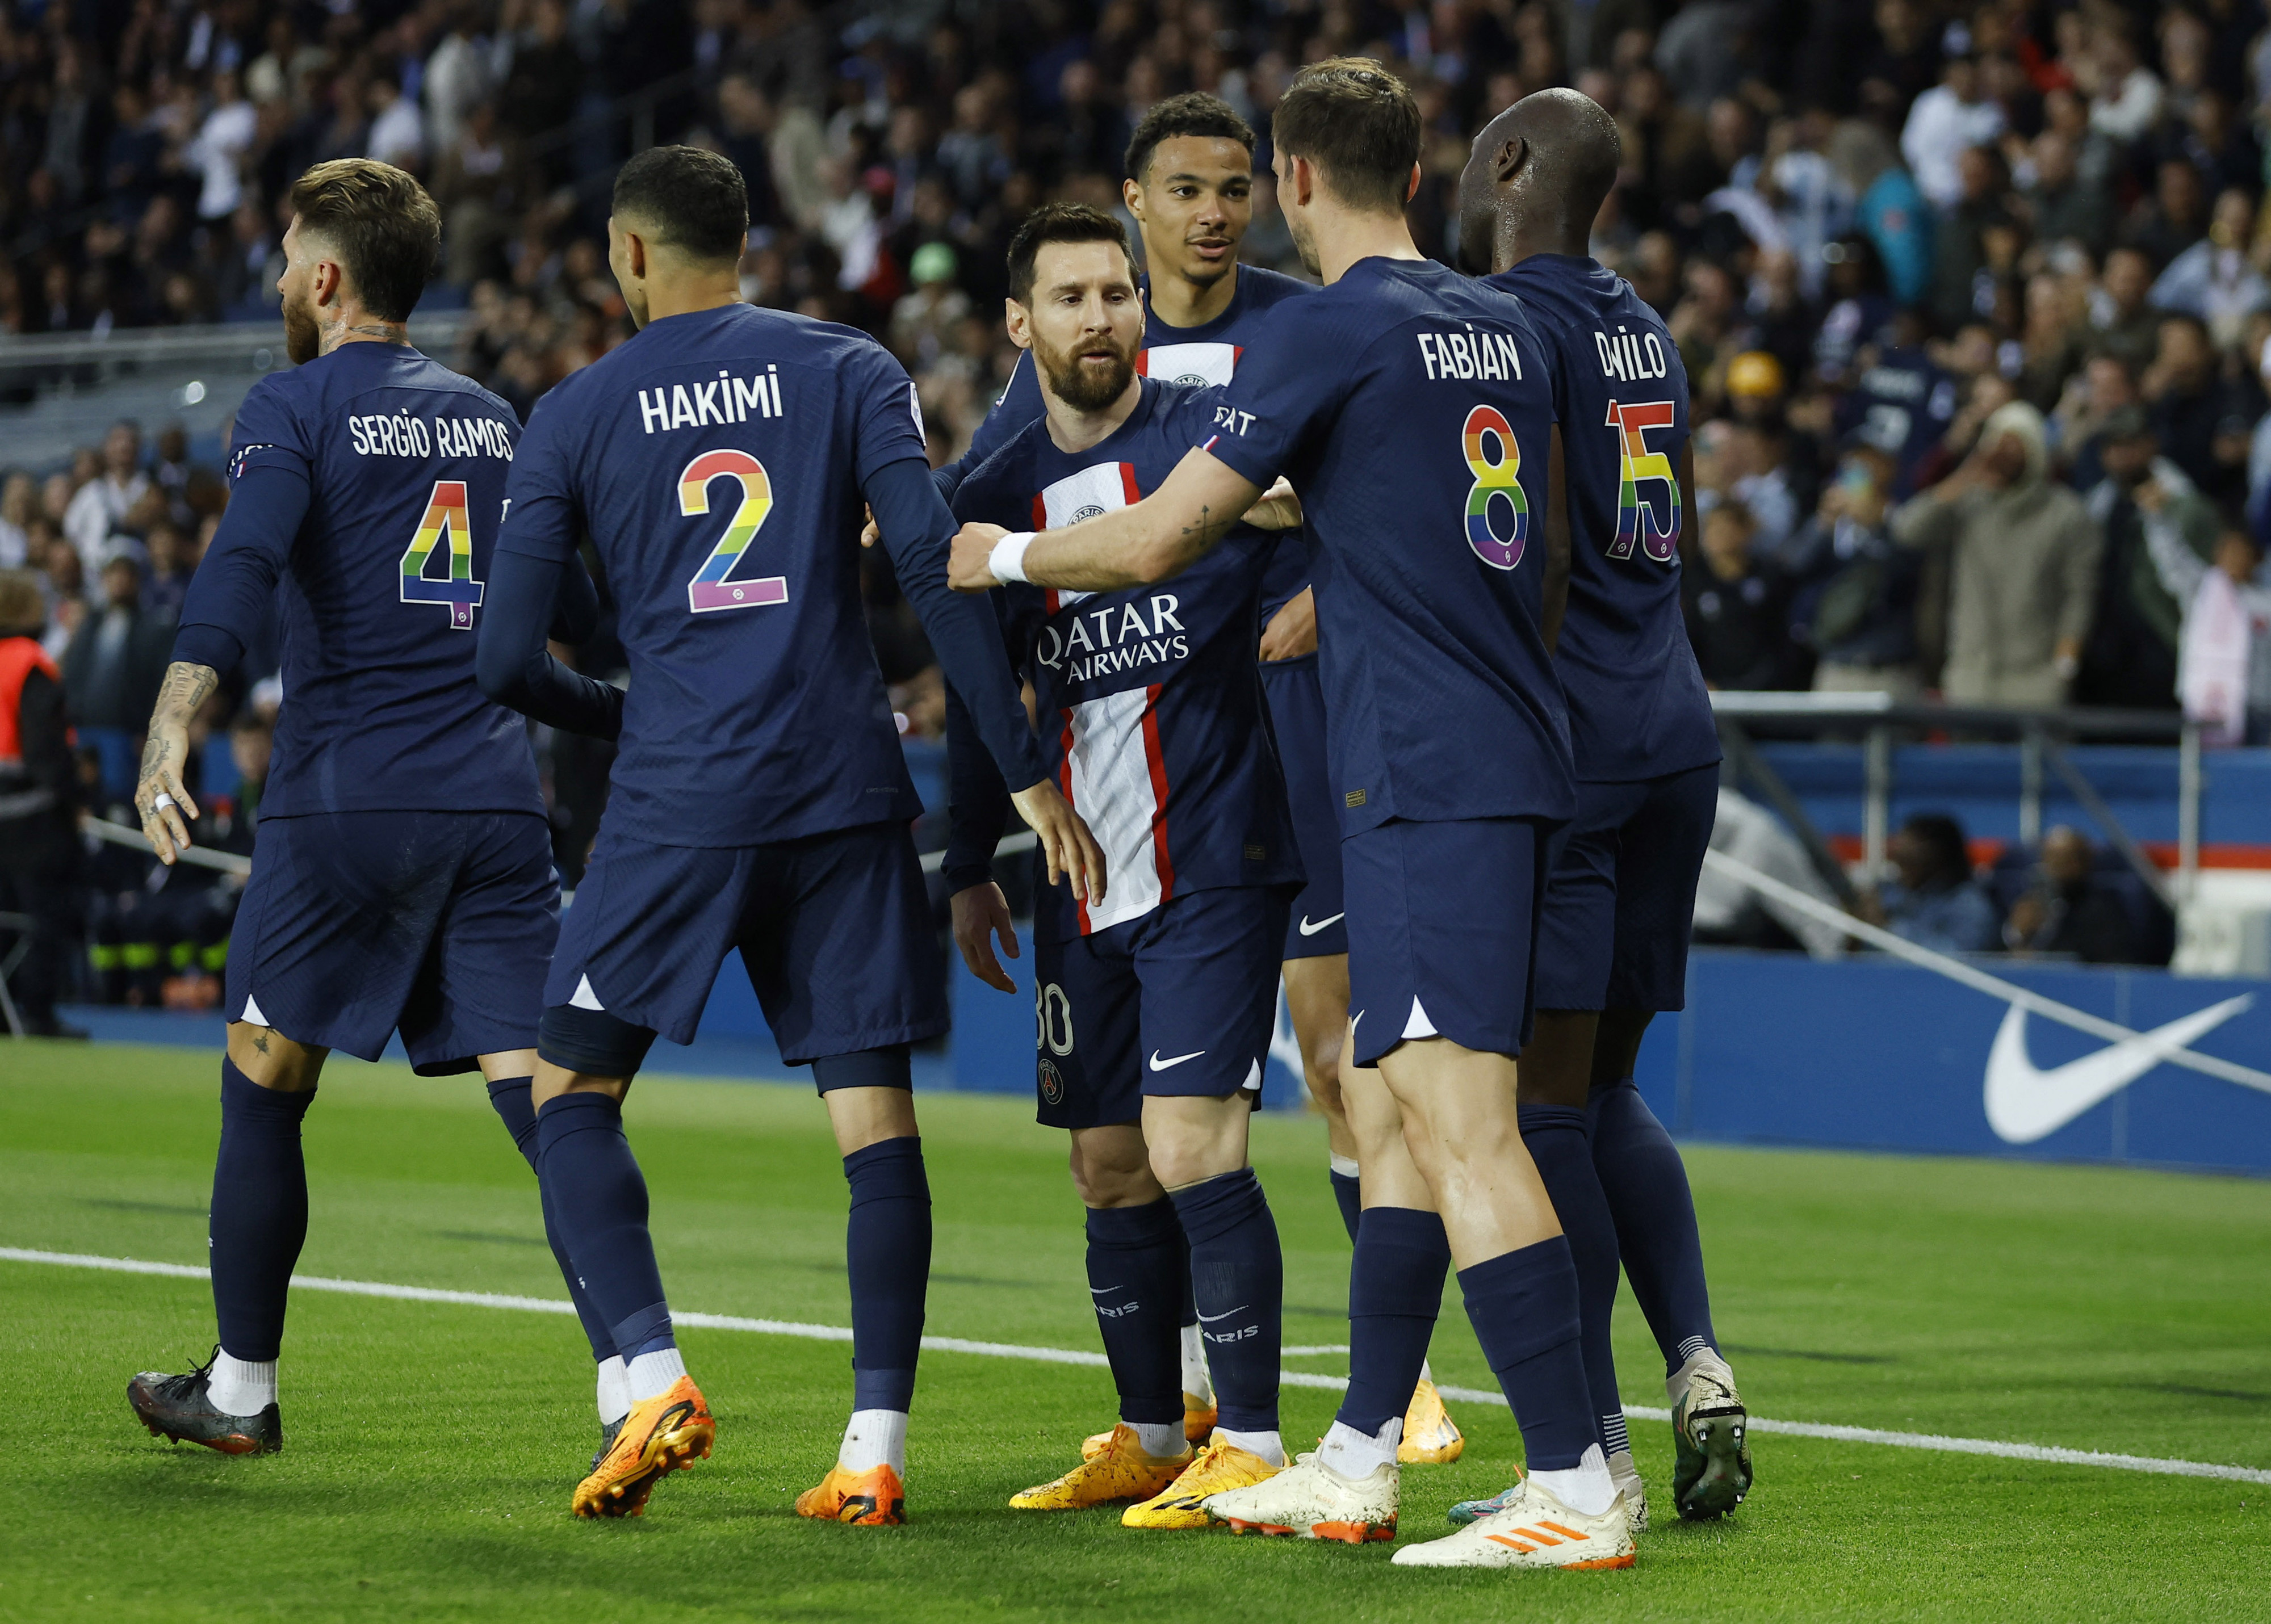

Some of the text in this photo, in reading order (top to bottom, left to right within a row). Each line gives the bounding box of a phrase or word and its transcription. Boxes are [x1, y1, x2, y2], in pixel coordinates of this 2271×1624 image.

[435, 417, 513, 461] RAMOS
[1461, 404, 1528, 570] 8
[1604, 398, 1681, 561] 15
[400, 480, 485, 630] 4
[677, 448, 789, 613] 2
[1037, 594, 1185, 670] QATAR
[1067, 635, 1189, 685] AIRWAYS
[1040, 1061, 1055, 1073] PARIS
